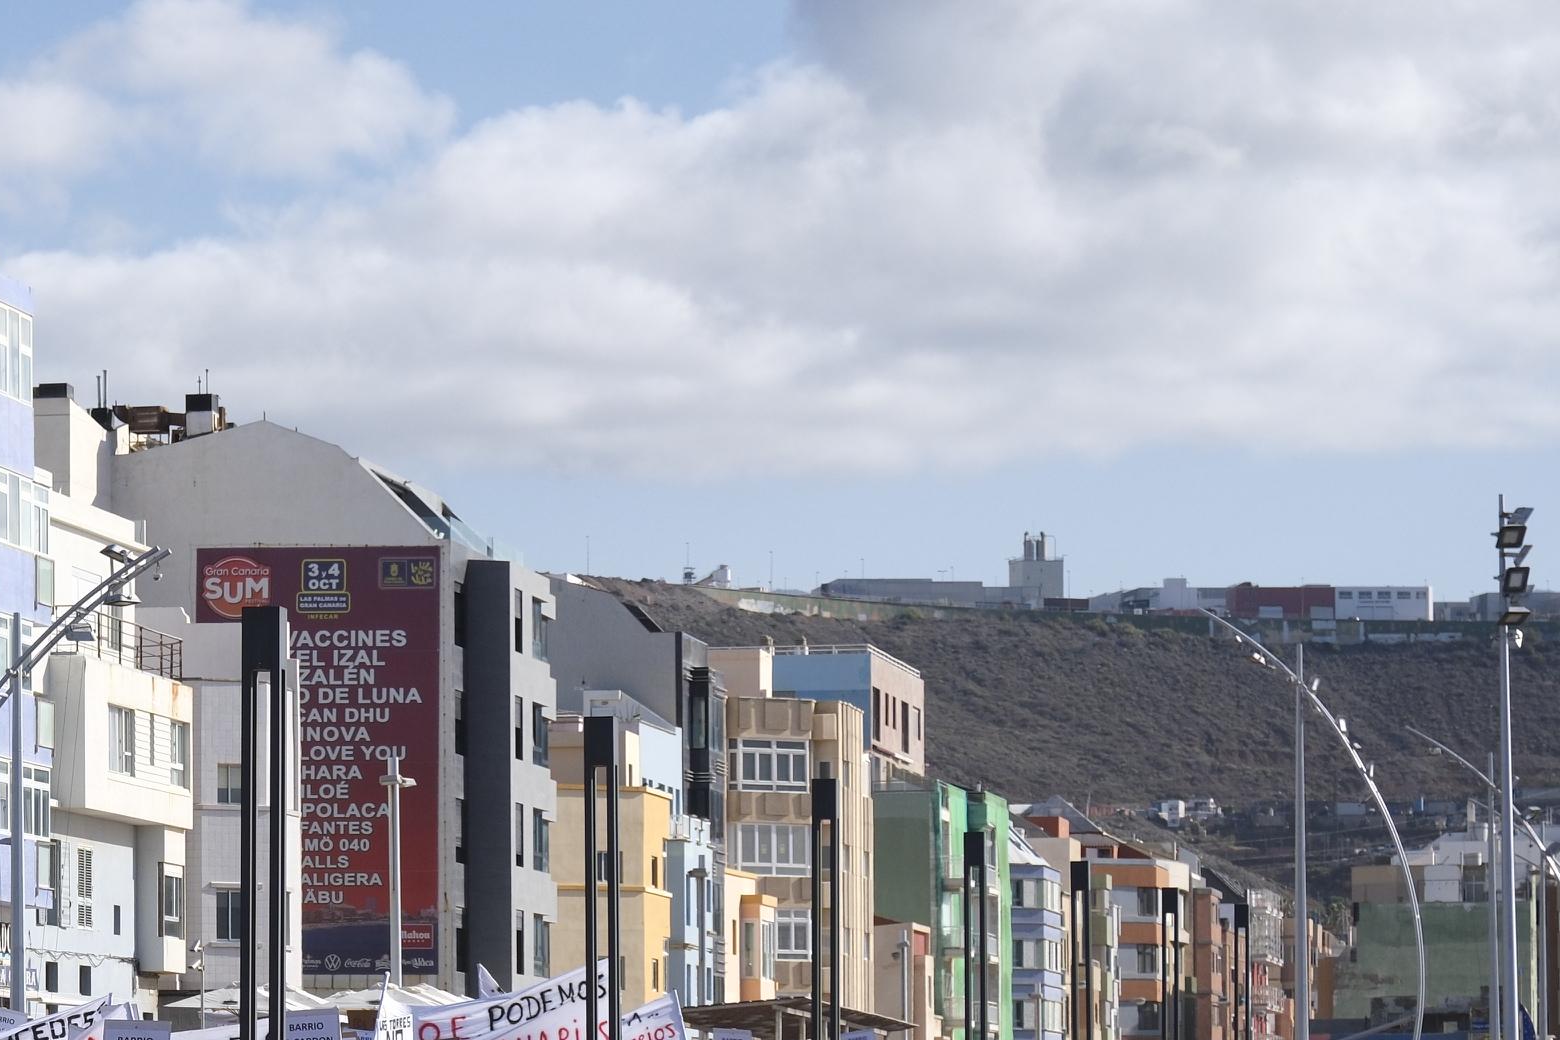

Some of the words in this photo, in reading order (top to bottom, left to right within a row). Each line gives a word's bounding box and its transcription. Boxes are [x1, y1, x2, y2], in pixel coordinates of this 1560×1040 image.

[205, 567, 229, 576] Gran
[231, 567, 270, 576] Canaria
[308, 563, 320, 577] 3
[328, 563, 340, 577] 4
[205, 577, 269, 604] SUM
[308, 579, 339, 590] OCT
[333, 649, 385, 666] IZAL
[299, 664, 375, 685] ZALÉN
[318, 687, 349, 704] DE
[358, 687, 422, 704] LUNA
[300, 708, 337, 722] CAN
[345, 708, 390, 722] DHU
[361, 746, 406, 761] YOU
[301, 765, 362, 780] HARA
[300, 821, 373, 834] FANTES
[302, 836, 333, 851] MÖ
[339, 838, 370, 851] 040
[301, 855, 349, 869] ALLS
[301, 872, 382, 886] ALIGERA
[303, 889, 343, 904] ÄBU
[289, 1022, 324, 1032] BARRIO
